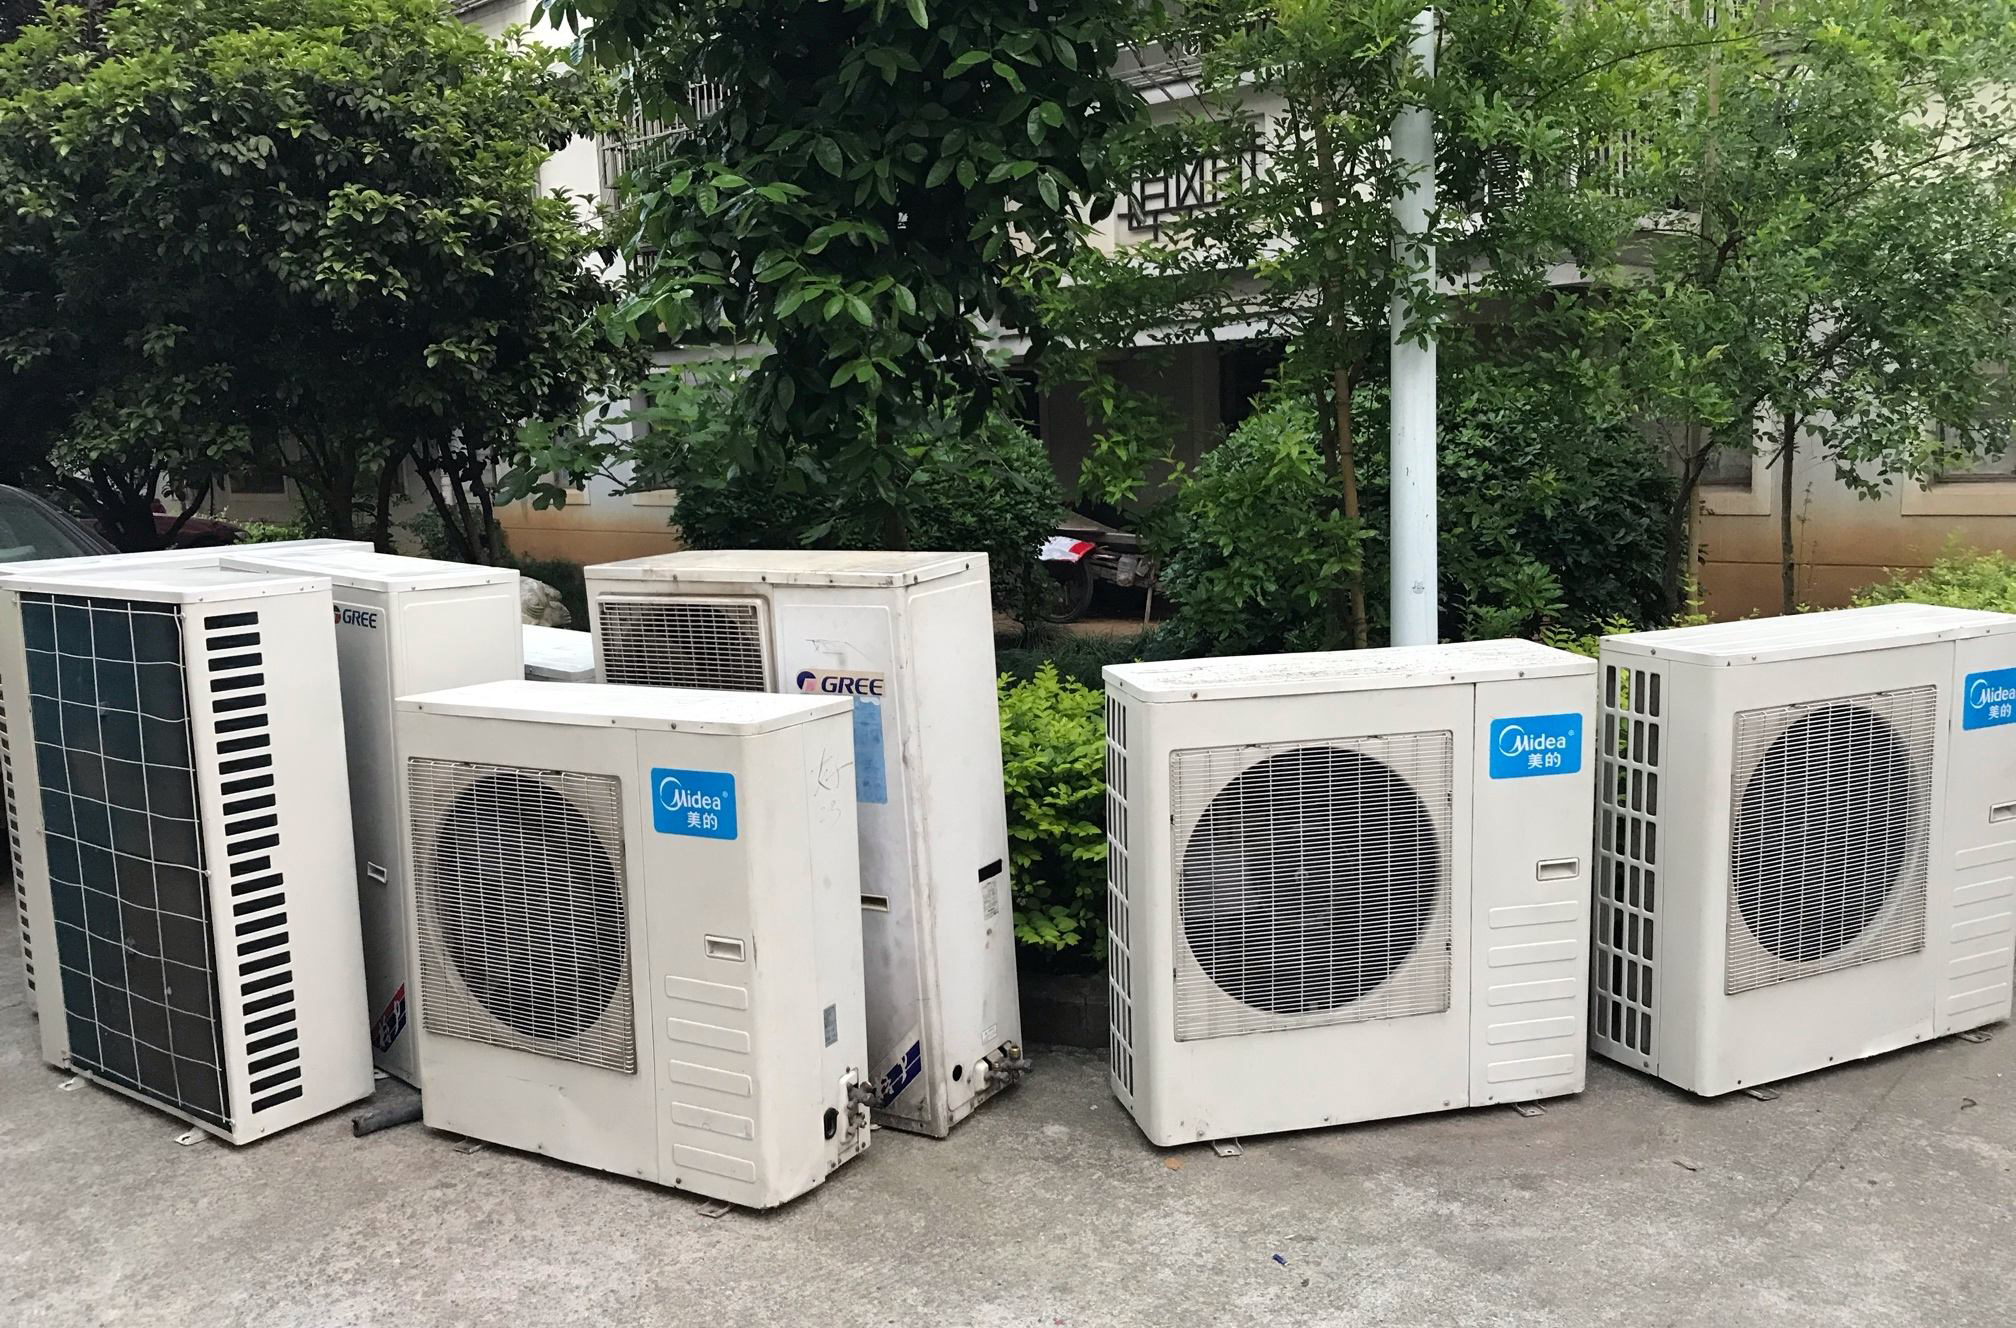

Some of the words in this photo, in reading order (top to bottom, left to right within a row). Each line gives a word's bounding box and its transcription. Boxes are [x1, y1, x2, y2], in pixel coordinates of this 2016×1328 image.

[342, 608, 378, 629] GREE
[821, 676, 883, 696] GREE
[1969, 678, 2016, 709] Midea
[1988, 703, 2012, 720] 美的
[1498, 724, 1567, 757] Midea
[1527, 751, 1562, 770] 美的
[659, 776, 721, 811] Midea
[687, 811, 718, 831] 美的
